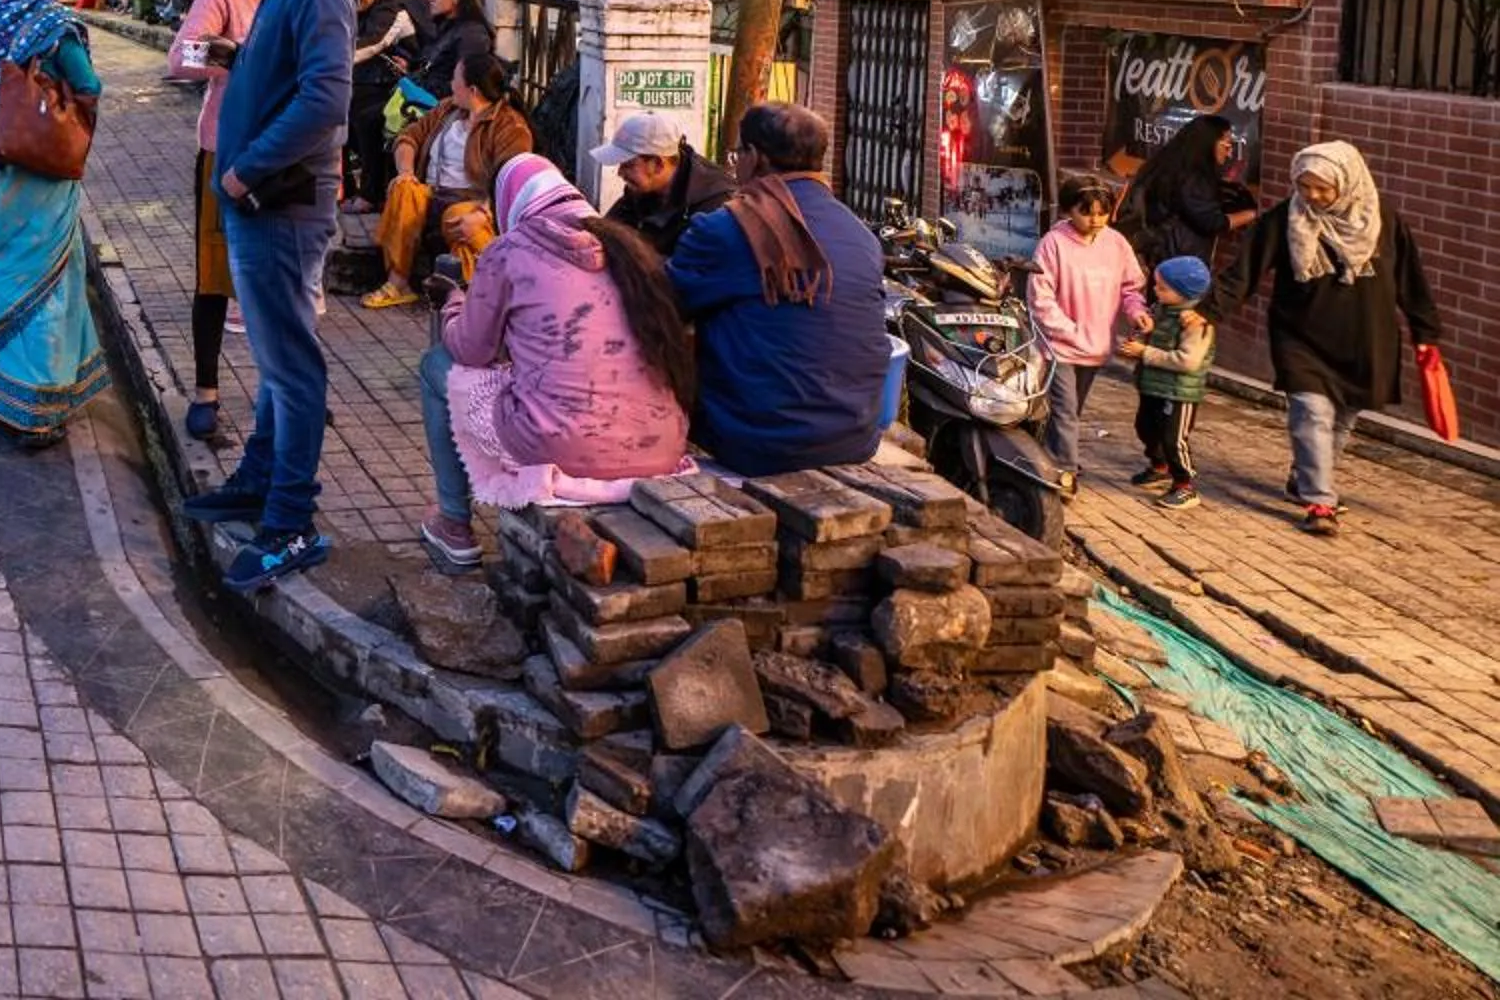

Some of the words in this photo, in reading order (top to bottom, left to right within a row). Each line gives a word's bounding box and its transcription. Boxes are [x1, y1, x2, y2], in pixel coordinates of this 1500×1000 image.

[619, 71, 635, 86] DO
[639, 71, 663, 89] NOT
[666, 71, 693, 87] SPIT
[643, 91, 694, 106] DUSTBIN
